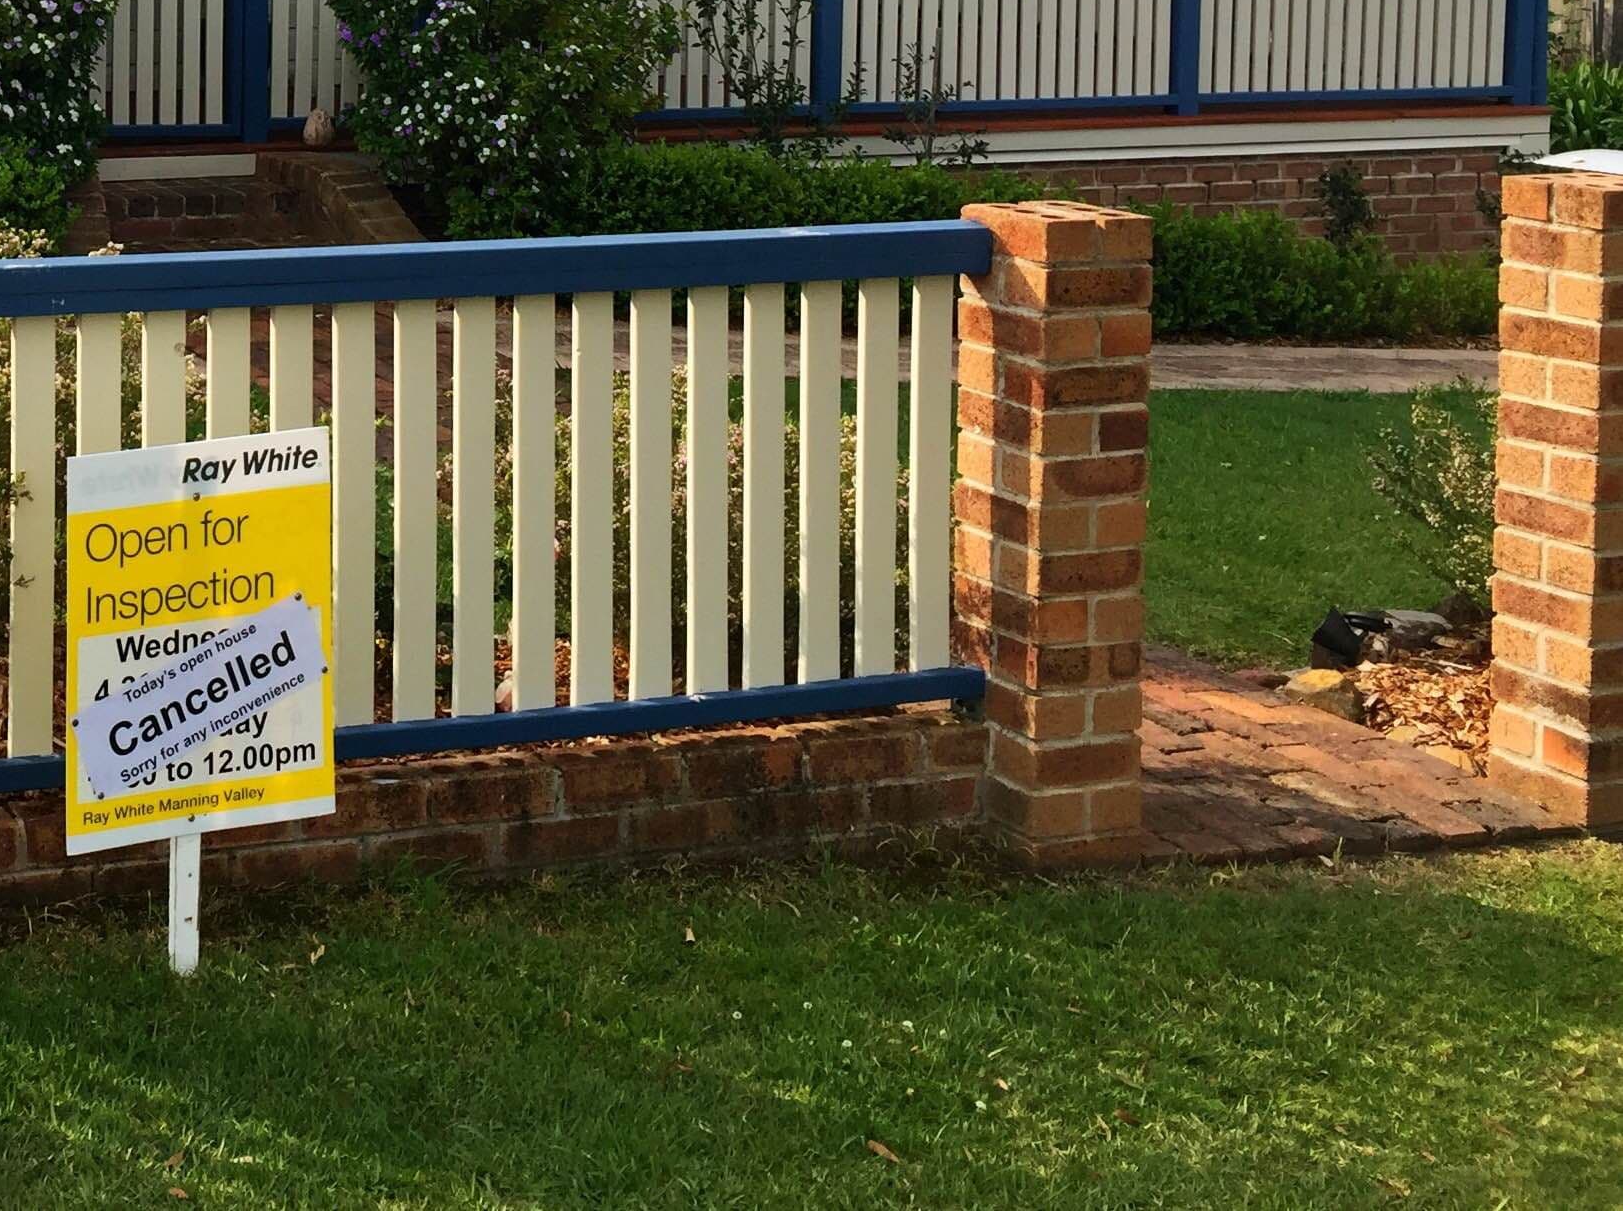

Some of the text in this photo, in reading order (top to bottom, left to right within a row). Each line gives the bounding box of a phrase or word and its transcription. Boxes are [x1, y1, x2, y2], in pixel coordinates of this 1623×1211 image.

[182, 457, 236, 483] Ray
[243, 445, 318, 476] White
[86, 509, 249, 568] Open for
[87, 568, 274, 626] Inspection
[122, 668, 177, 703] Today's
[179, 648, 213, 671] open
[216, 624, 257, 653] house
[109, 630, 296, 756] Cancelled
[120, 755, 158, 783] Sorry
[160, 742, 180, 760] for
[183, 725, 207, 748] any
[210, 672, 305, 733] inconvenience
[166, 762, 192, 782] to
[203, 742, 316, 775] 12.00pm
[83, 787, 265, 825] Ray White Manning Valley
